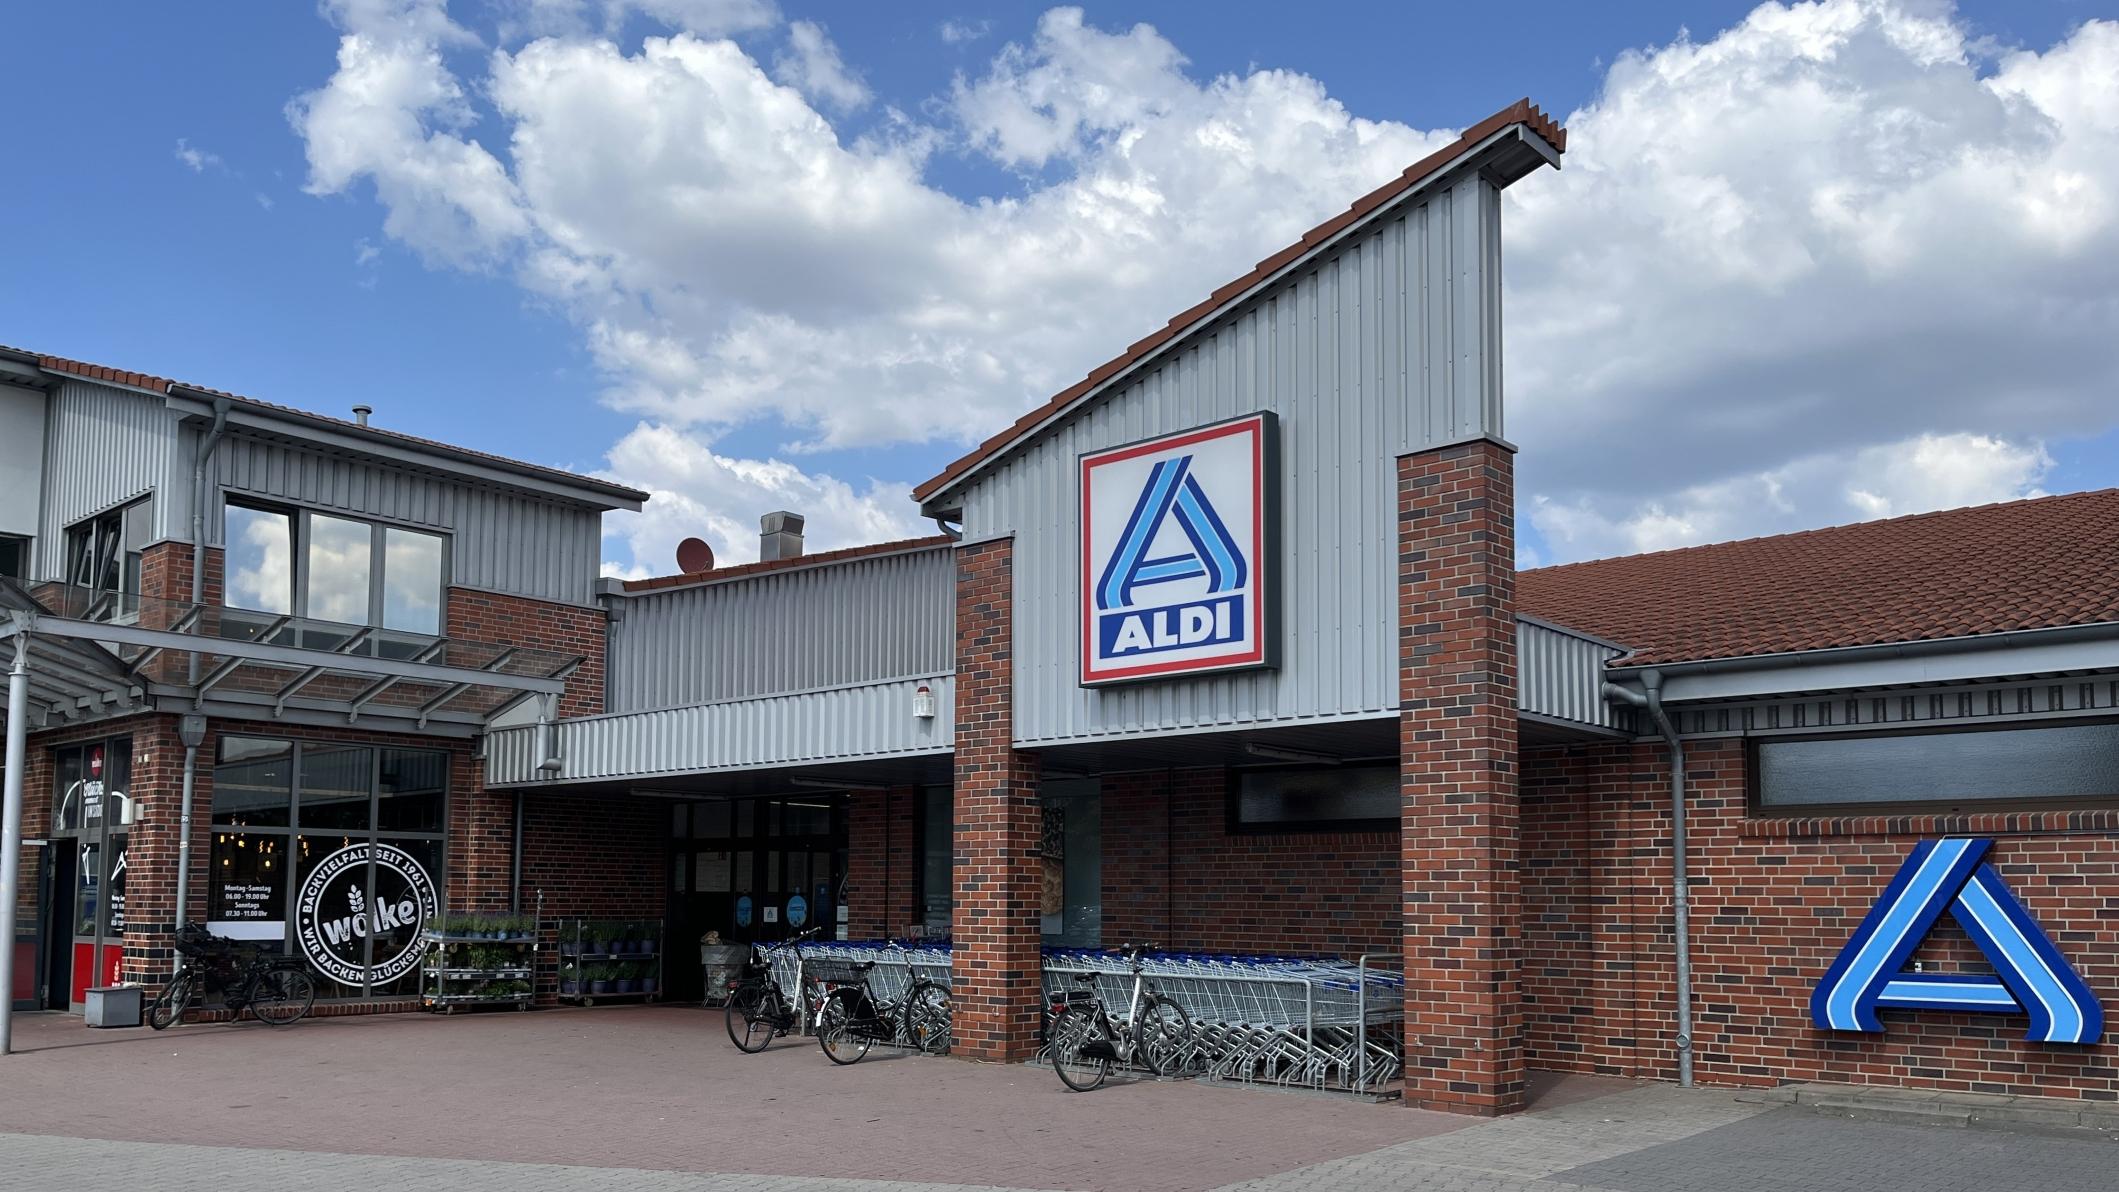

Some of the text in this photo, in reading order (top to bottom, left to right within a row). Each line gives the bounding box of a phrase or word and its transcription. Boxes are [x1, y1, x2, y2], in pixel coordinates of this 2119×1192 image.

[1111, 601, 1231, 654] ALDI
[302, 848, 425, 914] BACKVIELFALT SEIT 1961
[322, 896, 416, 946] wolke
[303, 927, 321, 956] WIR
[317, 952, 364, 981] BACKEN
